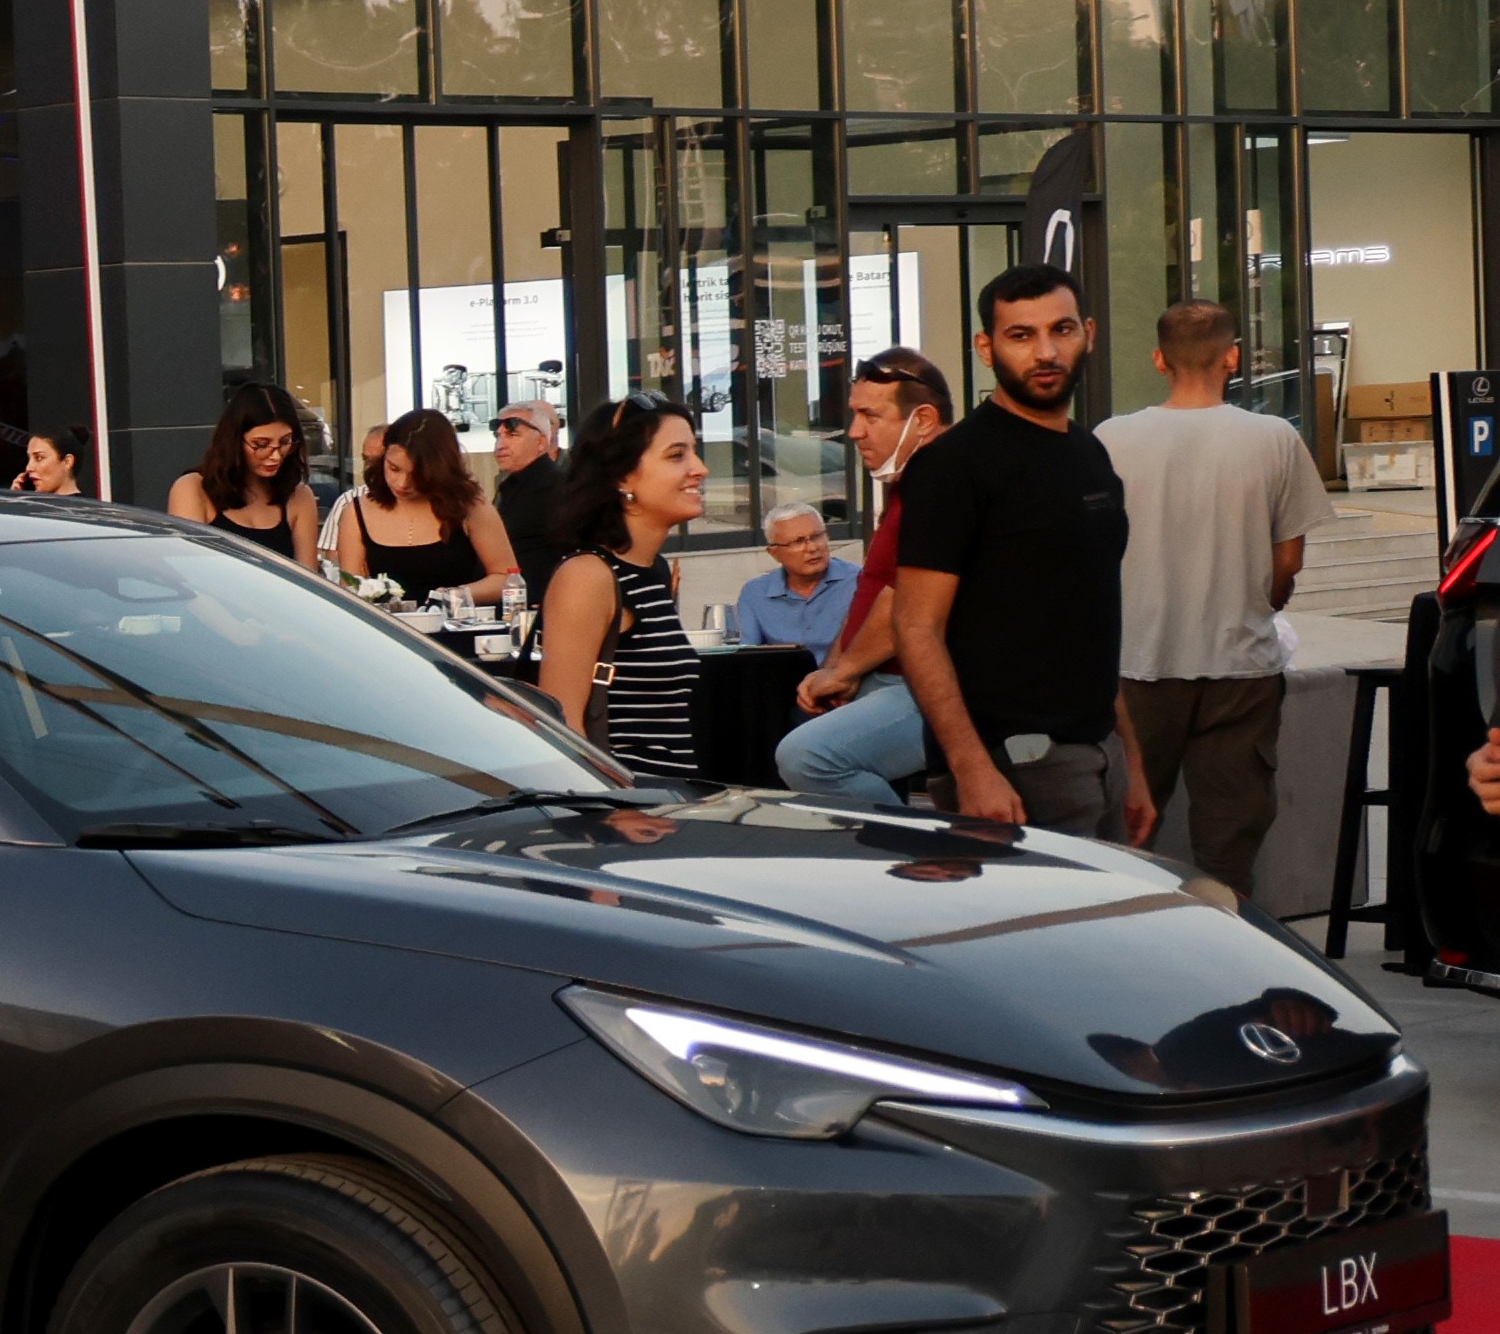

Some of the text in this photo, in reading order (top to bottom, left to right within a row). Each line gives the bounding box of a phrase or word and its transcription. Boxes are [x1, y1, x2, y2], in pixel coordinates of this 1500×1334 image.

[469, 297, 521, 308] e-Plaorm
[1472, 419, 1490, 453] P
[1321, 1251, 1379, 1316] LBX
